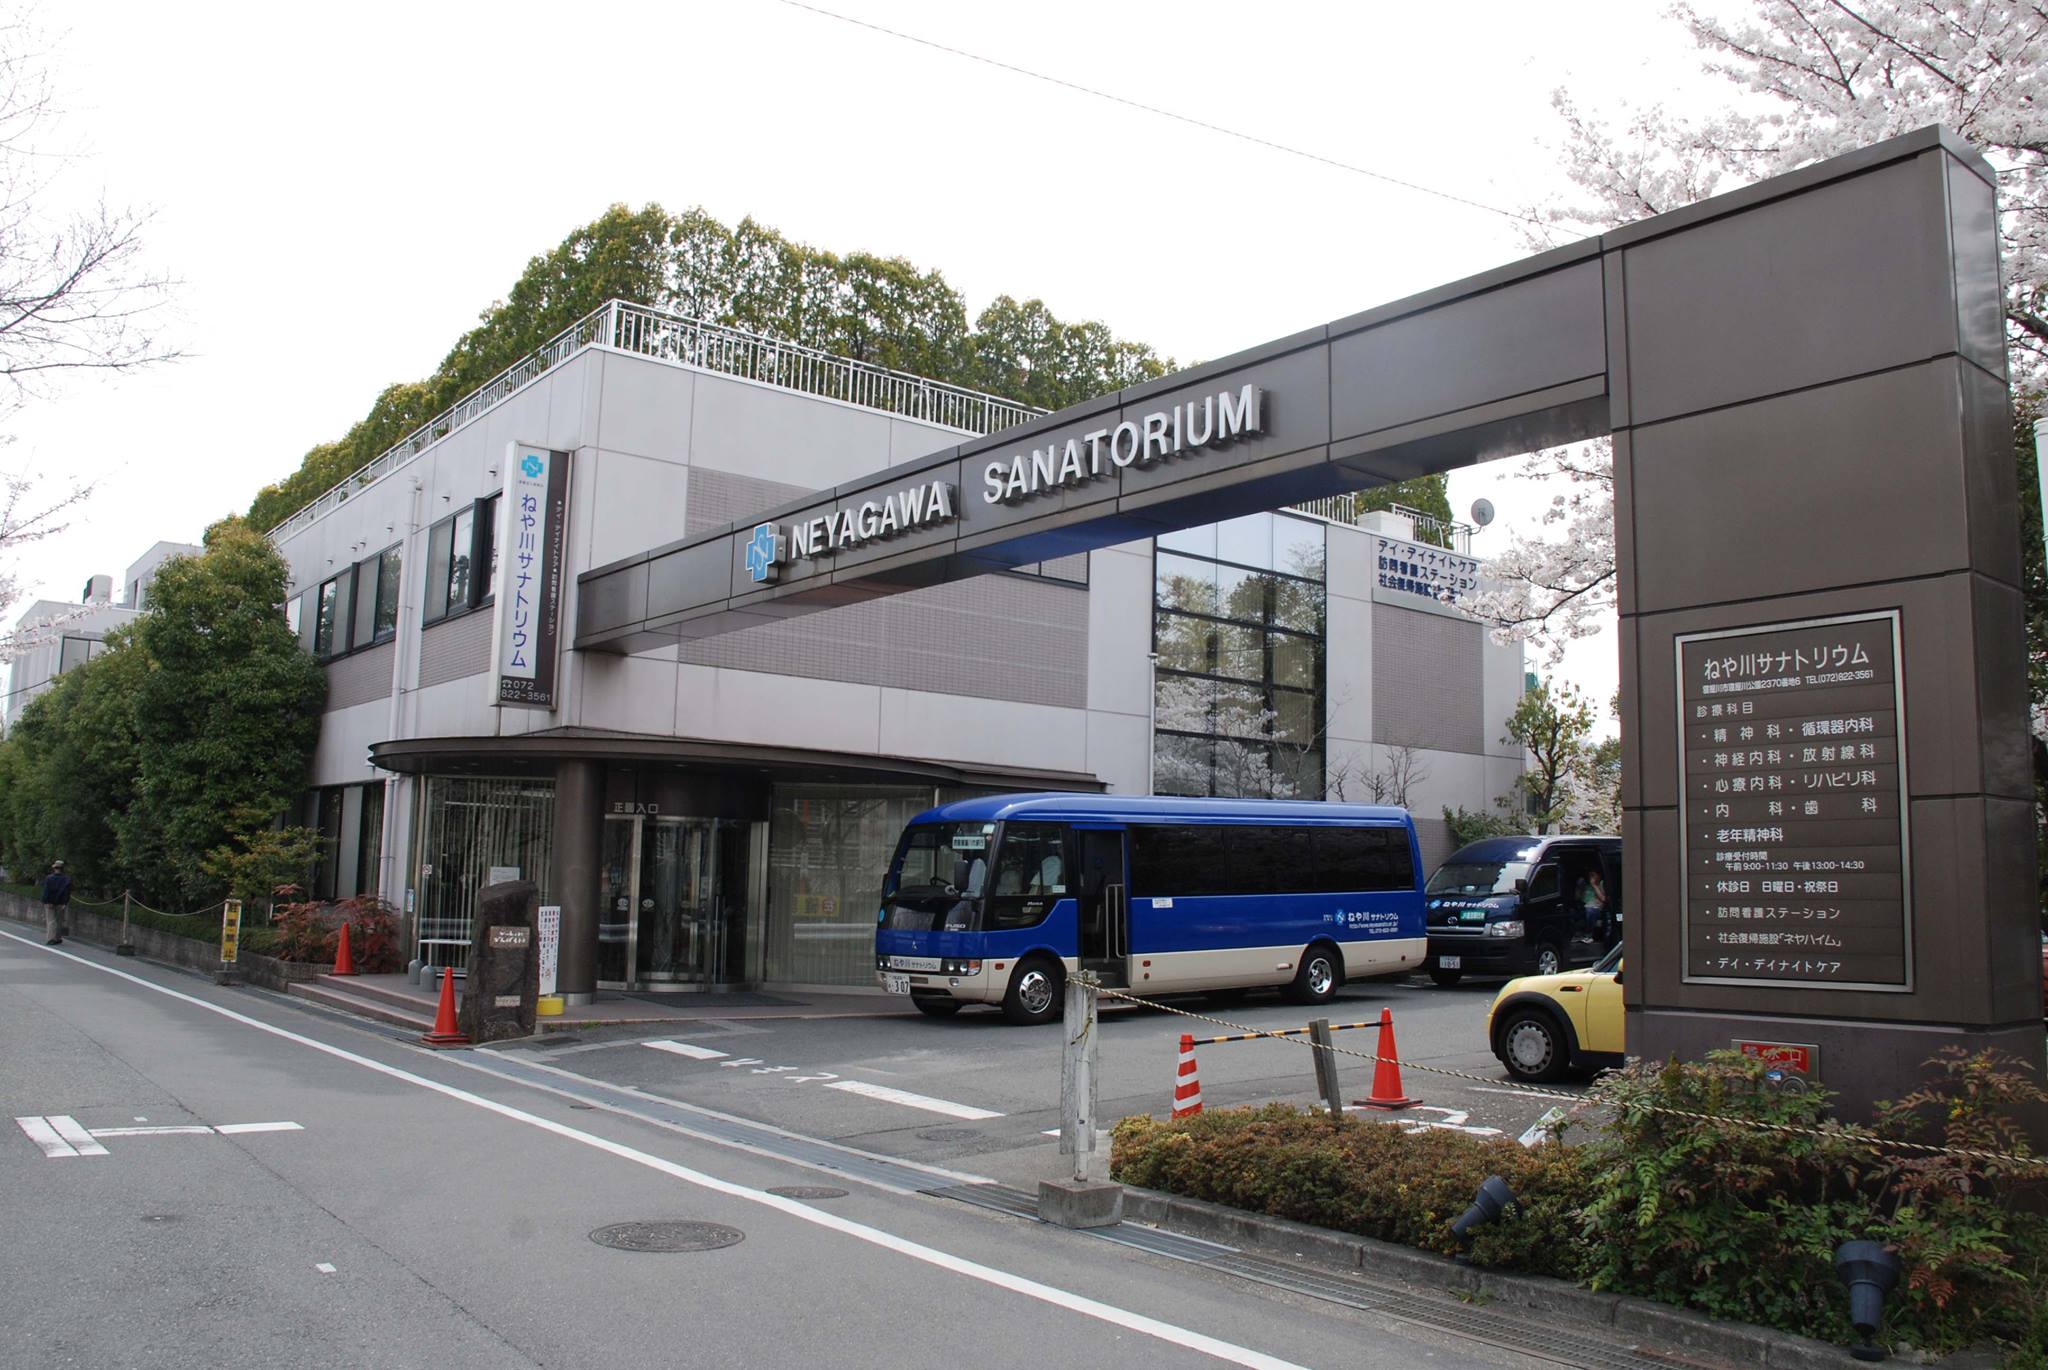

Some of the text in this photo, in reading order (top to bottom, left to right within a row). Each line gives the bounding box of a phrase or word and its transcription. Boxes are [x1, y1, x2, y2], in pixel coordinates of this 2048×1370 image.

[792, 384, 1263, 559] NEYAGAWA SANATORIUM
[511, 494, 537, 668] ねや川サナトリウム
[1704, 643, 1869, 681] ねや川サナトリウム
[513, 680, 534, 690] 072
[501, 689, 550, 701] 822-3561
[1696, 701, 1753, 718] 診療科目
[1801, 717, 1873, 737] 循環器内科
[1714, 744, 1876, 767] 神経内科 放射線科
[1715, 770, 1877, 793] 心療内科 リハビリ科
[1716, 827, 1783, 843] 老年精神科
[1716, 881, 1750, 893] 休診日
[1717, 907, 1840, 919] 訪問看護ステーション
[1718, 957, 1841, 973] デイ・デイナイトケア
